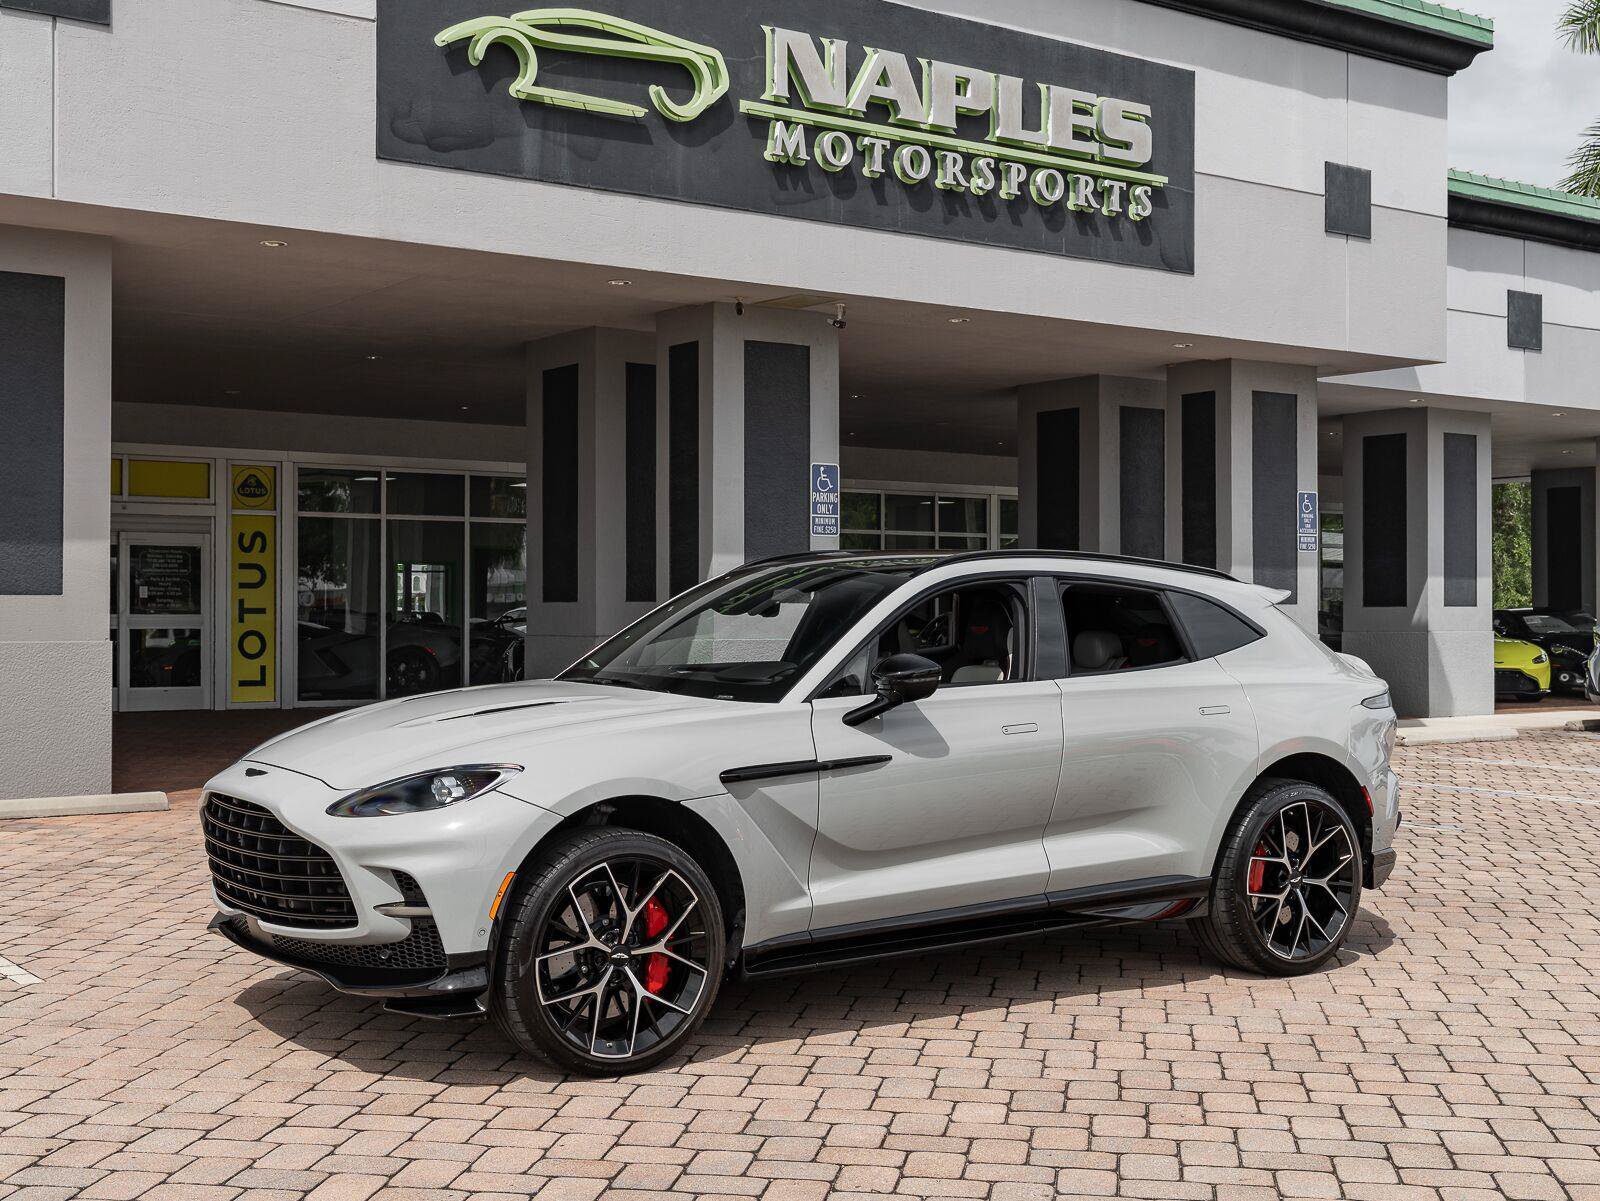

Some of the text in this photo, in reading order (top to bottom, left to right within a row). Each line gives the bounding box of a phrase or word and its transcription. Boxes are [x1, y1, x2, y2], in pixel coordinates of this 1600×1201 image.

[760, 24, 1153, 168] NAPLES
[763, 119, 1153, 222] MOTORSPORTS
[239, 487, 267, 495] LOTUS
[812, 491, 838, 503] PARKING
[816, 503, 834, 514] ONLY
[815, 517, 835, 525] MINIMUM
[813, 525, 837, 534] FINE $250
[237, 530, 267, 688] LOTUS
